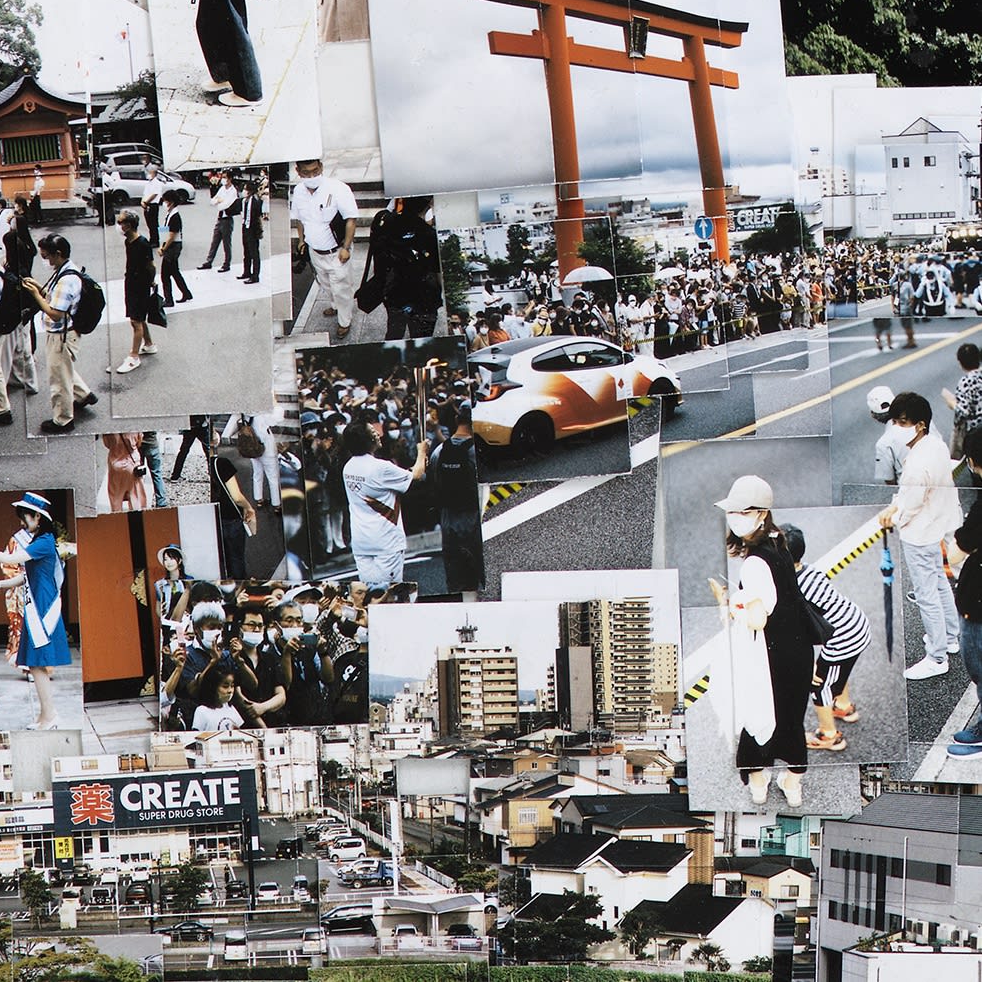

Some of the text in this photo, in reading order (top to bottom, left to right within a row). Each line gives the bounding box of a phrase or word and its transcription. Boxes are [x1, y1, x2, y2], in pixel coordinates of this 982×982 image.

[737, 207, 780, 225] CREAT
[70, 784, 115, 825] 薬
[120, 776, 240, 811] CREATE
[139, 806, 224, 822] SUPER DRUG STORE
